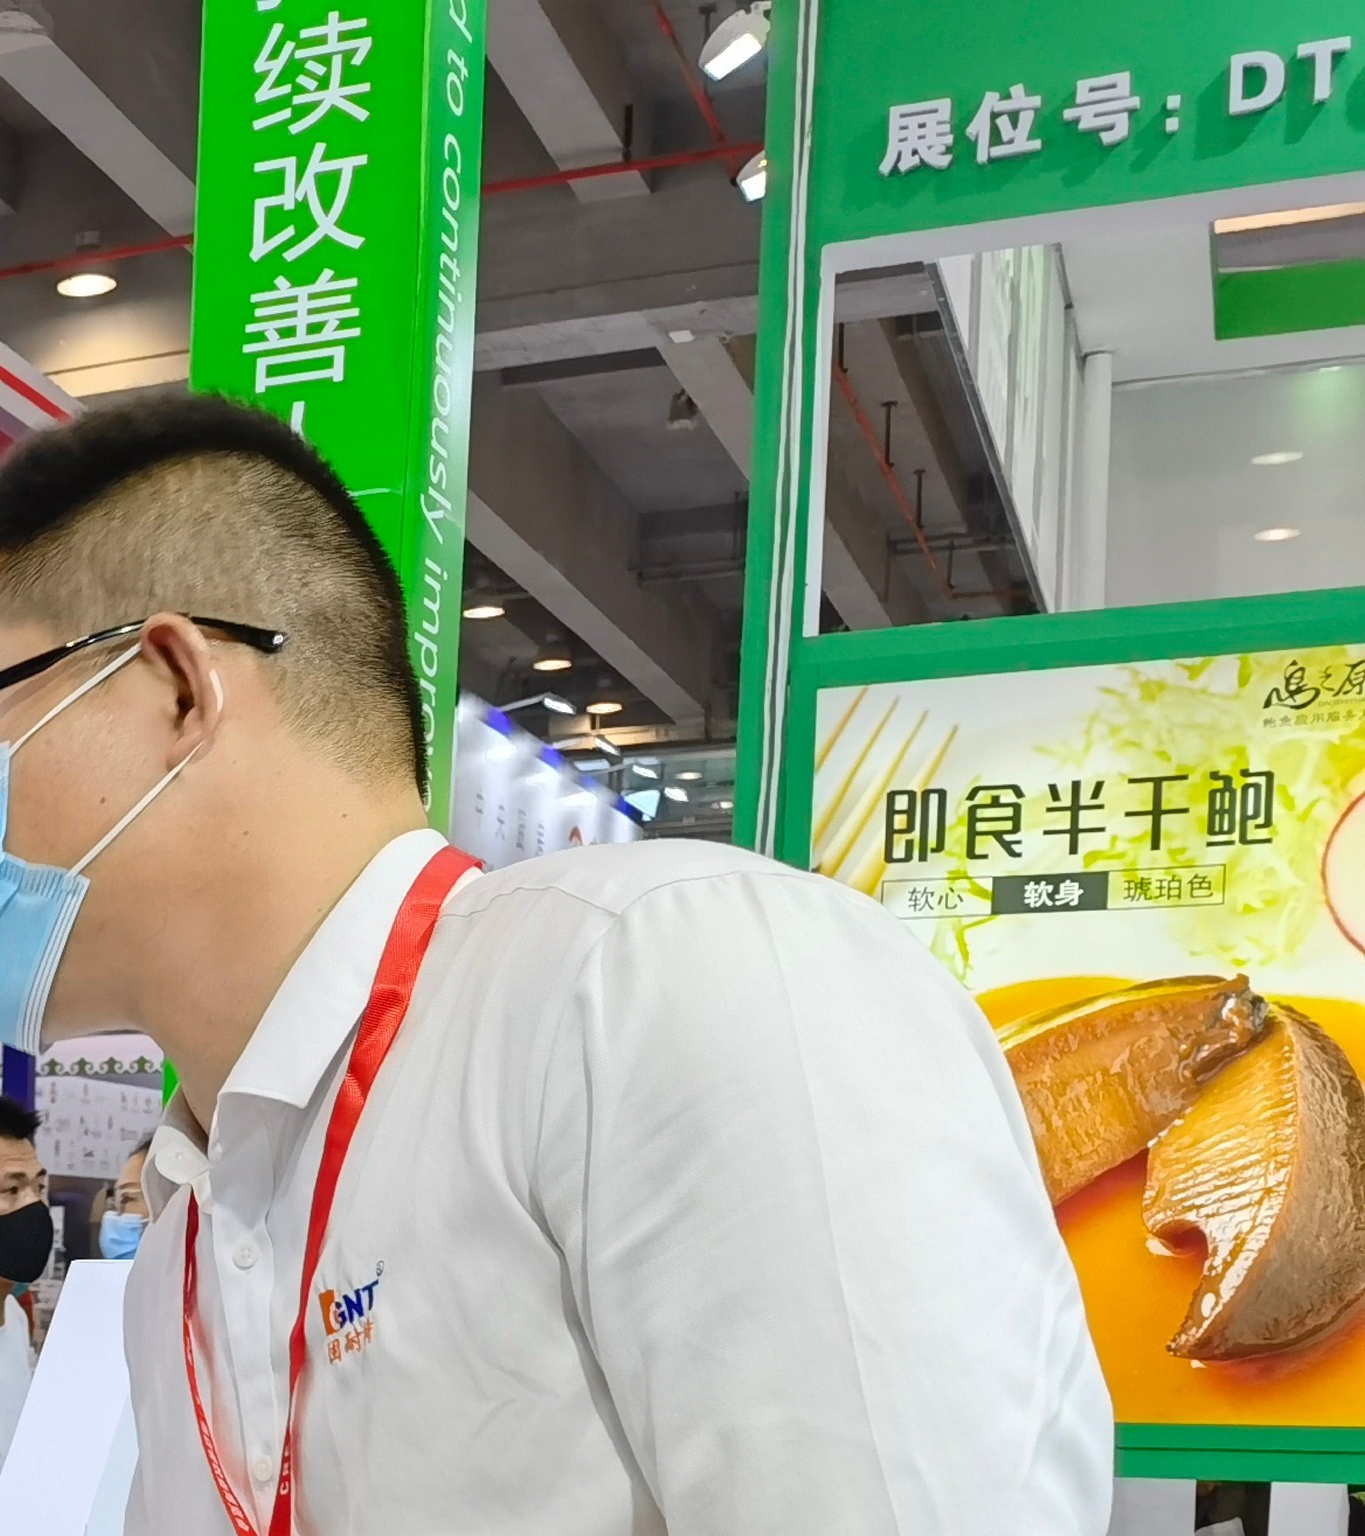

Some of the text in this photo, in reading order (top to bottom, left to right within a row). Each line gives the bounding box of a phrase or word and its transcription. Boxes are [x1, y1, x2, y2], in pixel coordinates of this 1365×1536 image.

[444, 53, 469, 117] to
[420, 133, 462, 545] continuously
[882, 767, 1276, 864] 即食半干鲍
[907, 872, 1215, 912] 软心 软身 琥珀色
[322, 1280, 379, 1334] GNT
